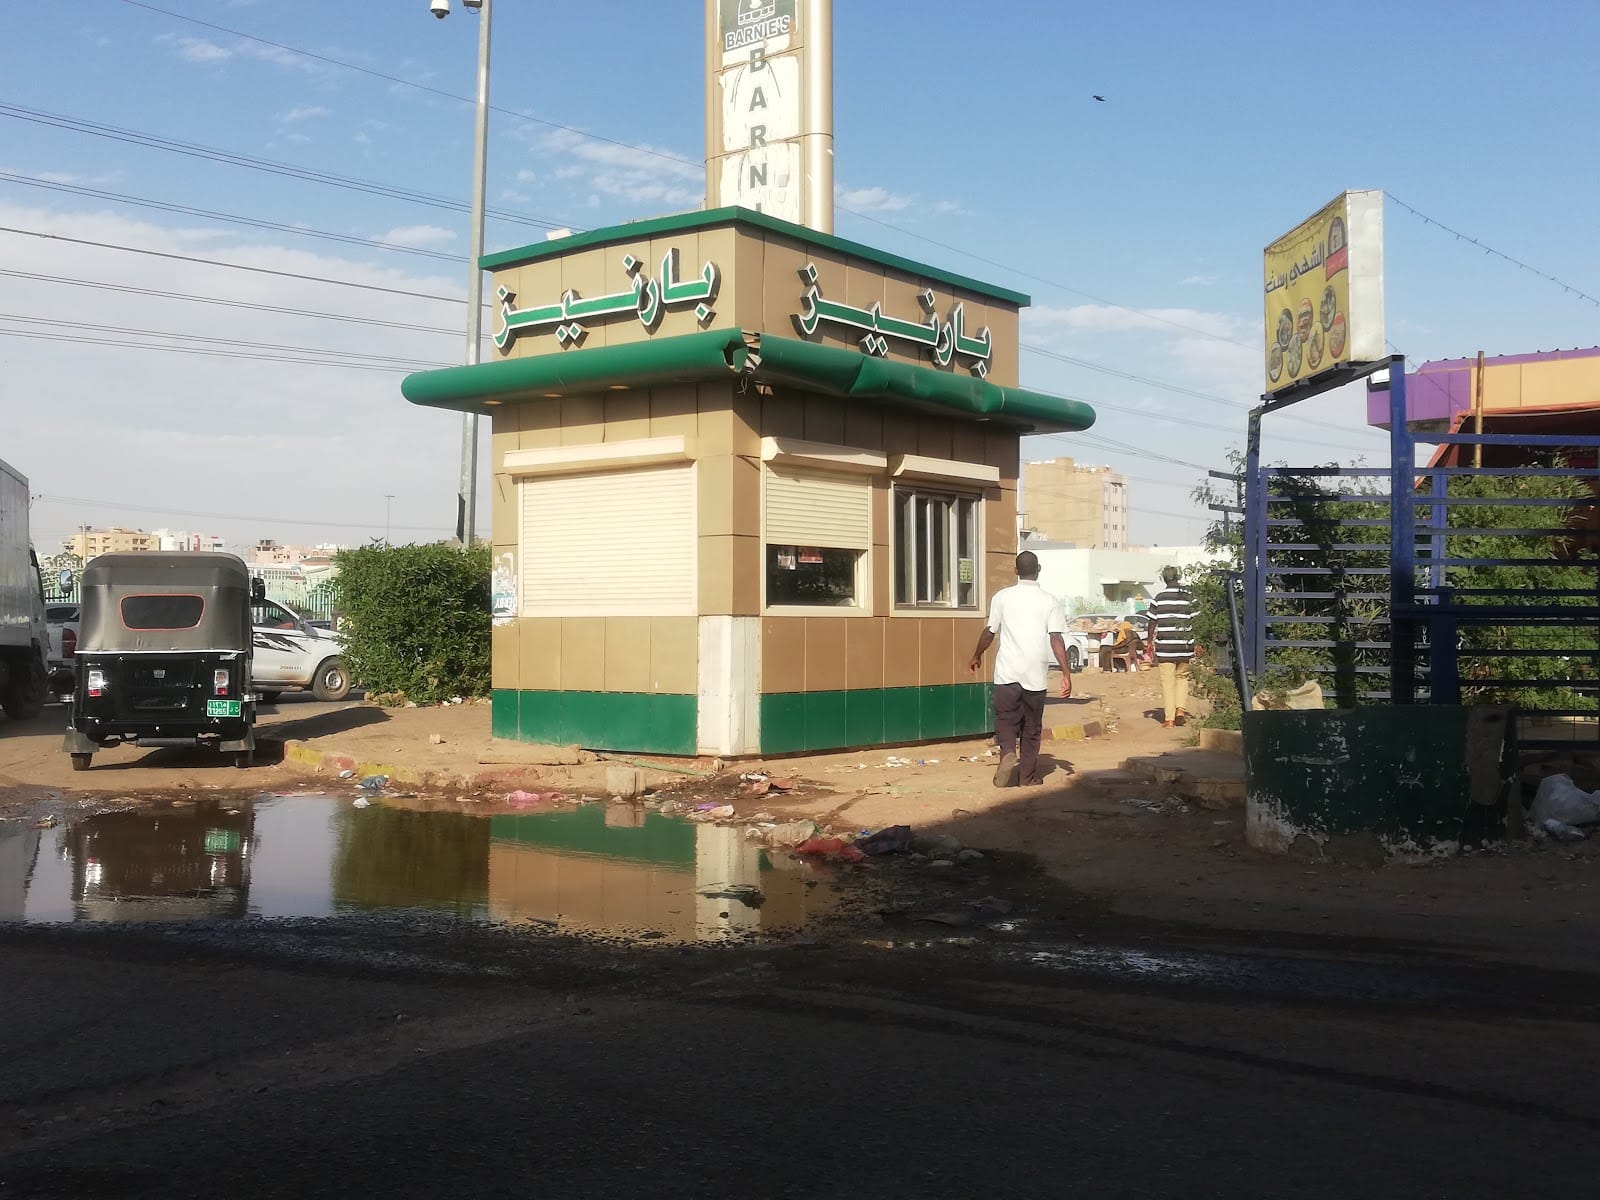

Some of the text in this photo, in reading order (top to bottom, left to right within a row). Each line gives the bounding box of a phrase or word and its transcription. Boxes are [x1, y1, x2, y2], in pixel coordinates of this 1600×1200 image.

[726, 15, 790, 49] BARNIE'S
[492, 247, 716, 349] بارنيز
[798, 261, 991, 379] بارنيز
